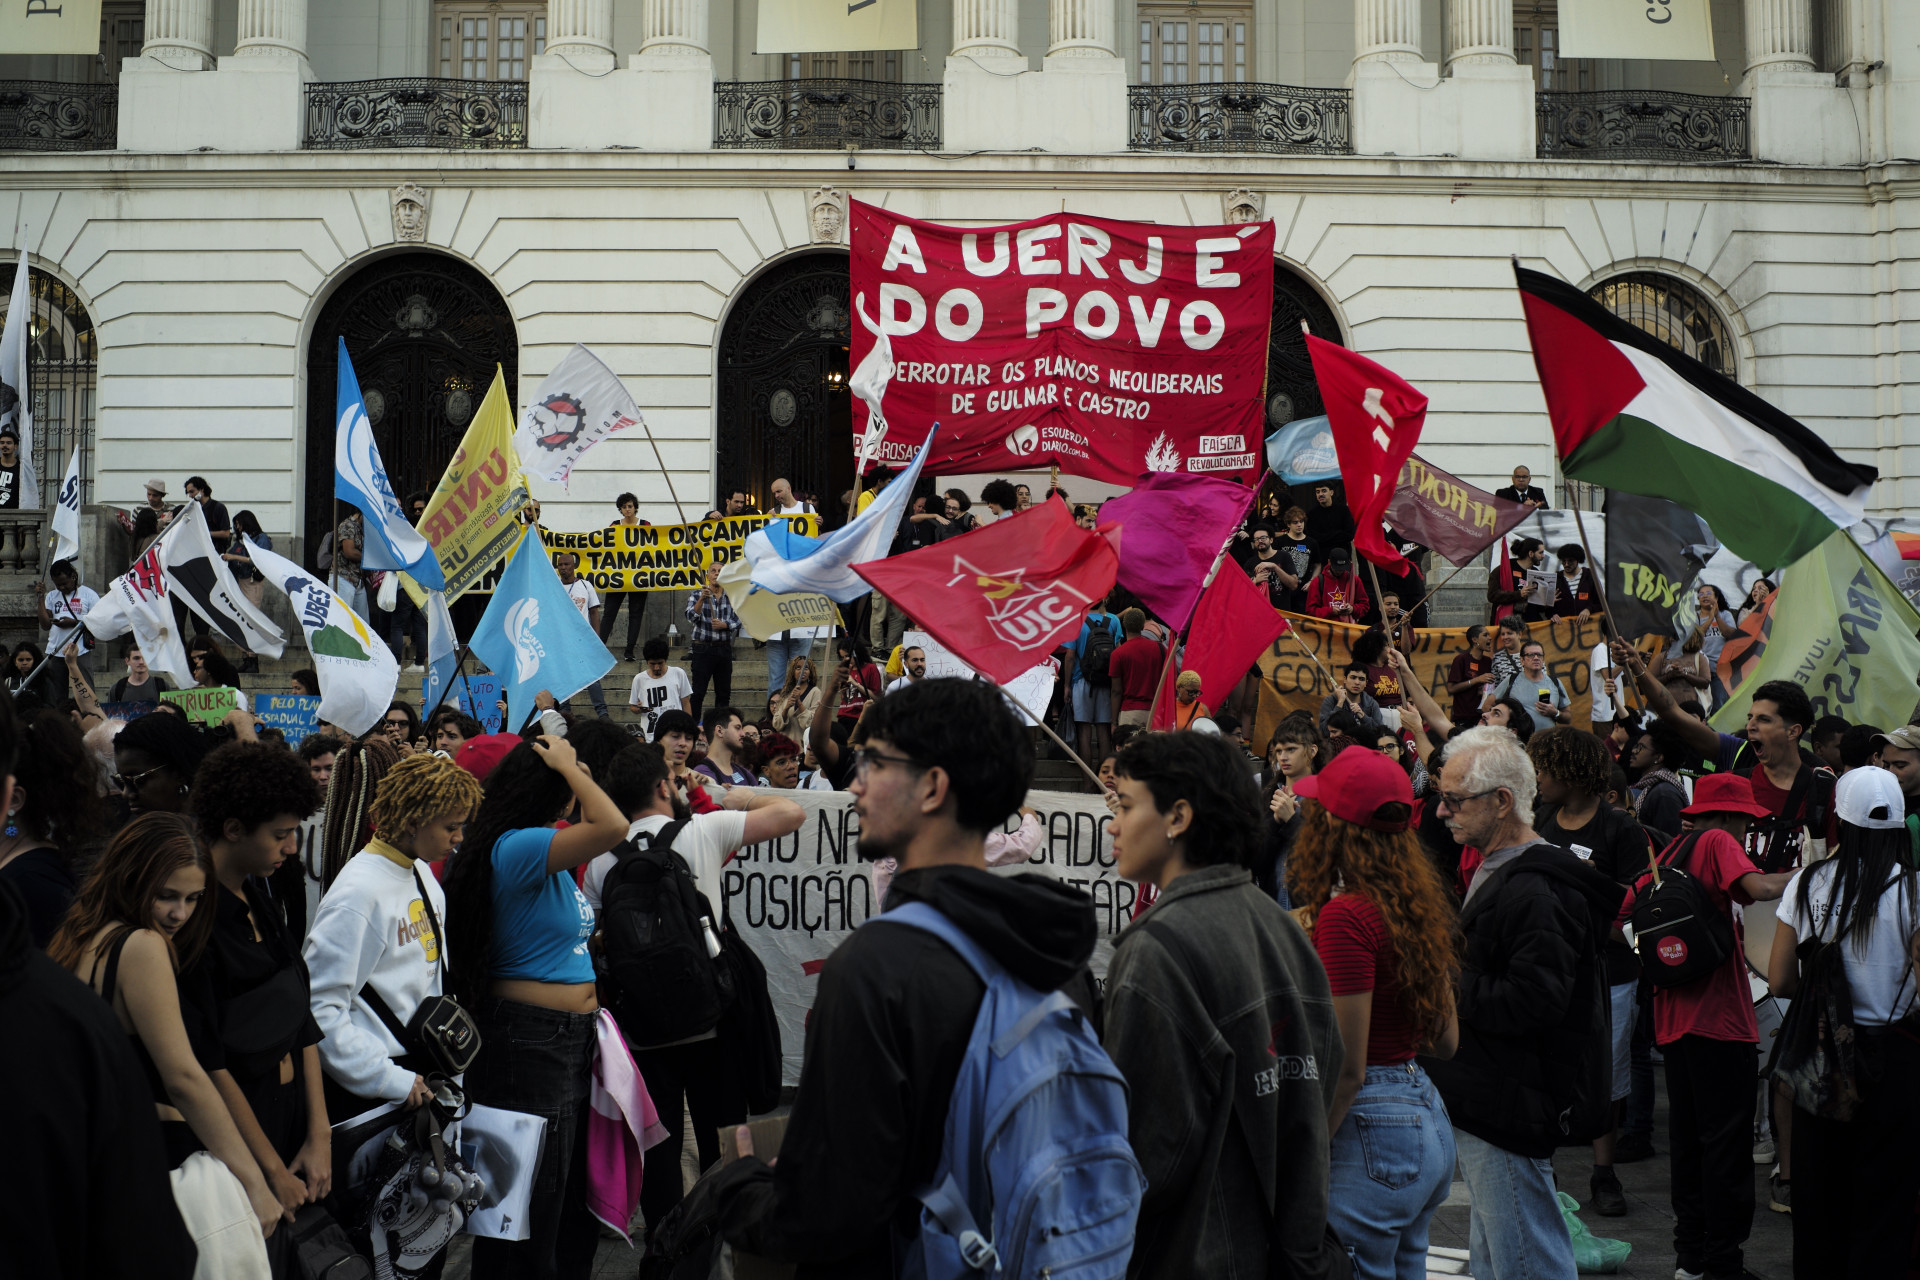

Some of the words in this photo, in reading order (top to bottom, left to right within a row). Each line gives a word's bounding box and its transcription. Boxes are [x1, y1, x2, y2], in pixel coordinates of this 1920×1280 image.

[882, 224, 928, 275] A
[961, 222, 1165, 286] UERJ
[1195, 225, 1261, 289] É
[880, 282, 984, 342] DO
[1026, 286, 1226, 351] POVO
[1001, 361, 1026, 384] OS
[1034, 354, 1100, 385] PLANOS
[1109, 368, 1224, 395] NEOLIBERAIS
[951, 392, 976, 415] DE
[986, 383, 1058, 413] GULNAR
[1063, 386, 1073, 407] E
[1078, 393, 1152, 421] CASTRO
[1041, 426, 1090, 447] ESQUERDA
[1202, 436, 1242, 452] FAÍSCA
[540, 527, 615, 549] MERECE
[625, 527, 659, 547] UM
[669, 517, 808, 547] ORÇAMEO
[586, 547, 704, 570] TAMANHO
[633, 569, 705, 590] GIGAN
[302, 585, 331, 629] UBES
[1000, 596, 1074, 642] UJC
[270, 696, 296, 710] PELO
[298, 698, 322, 711] PLAN
[646, 685, 668, 708] UP
